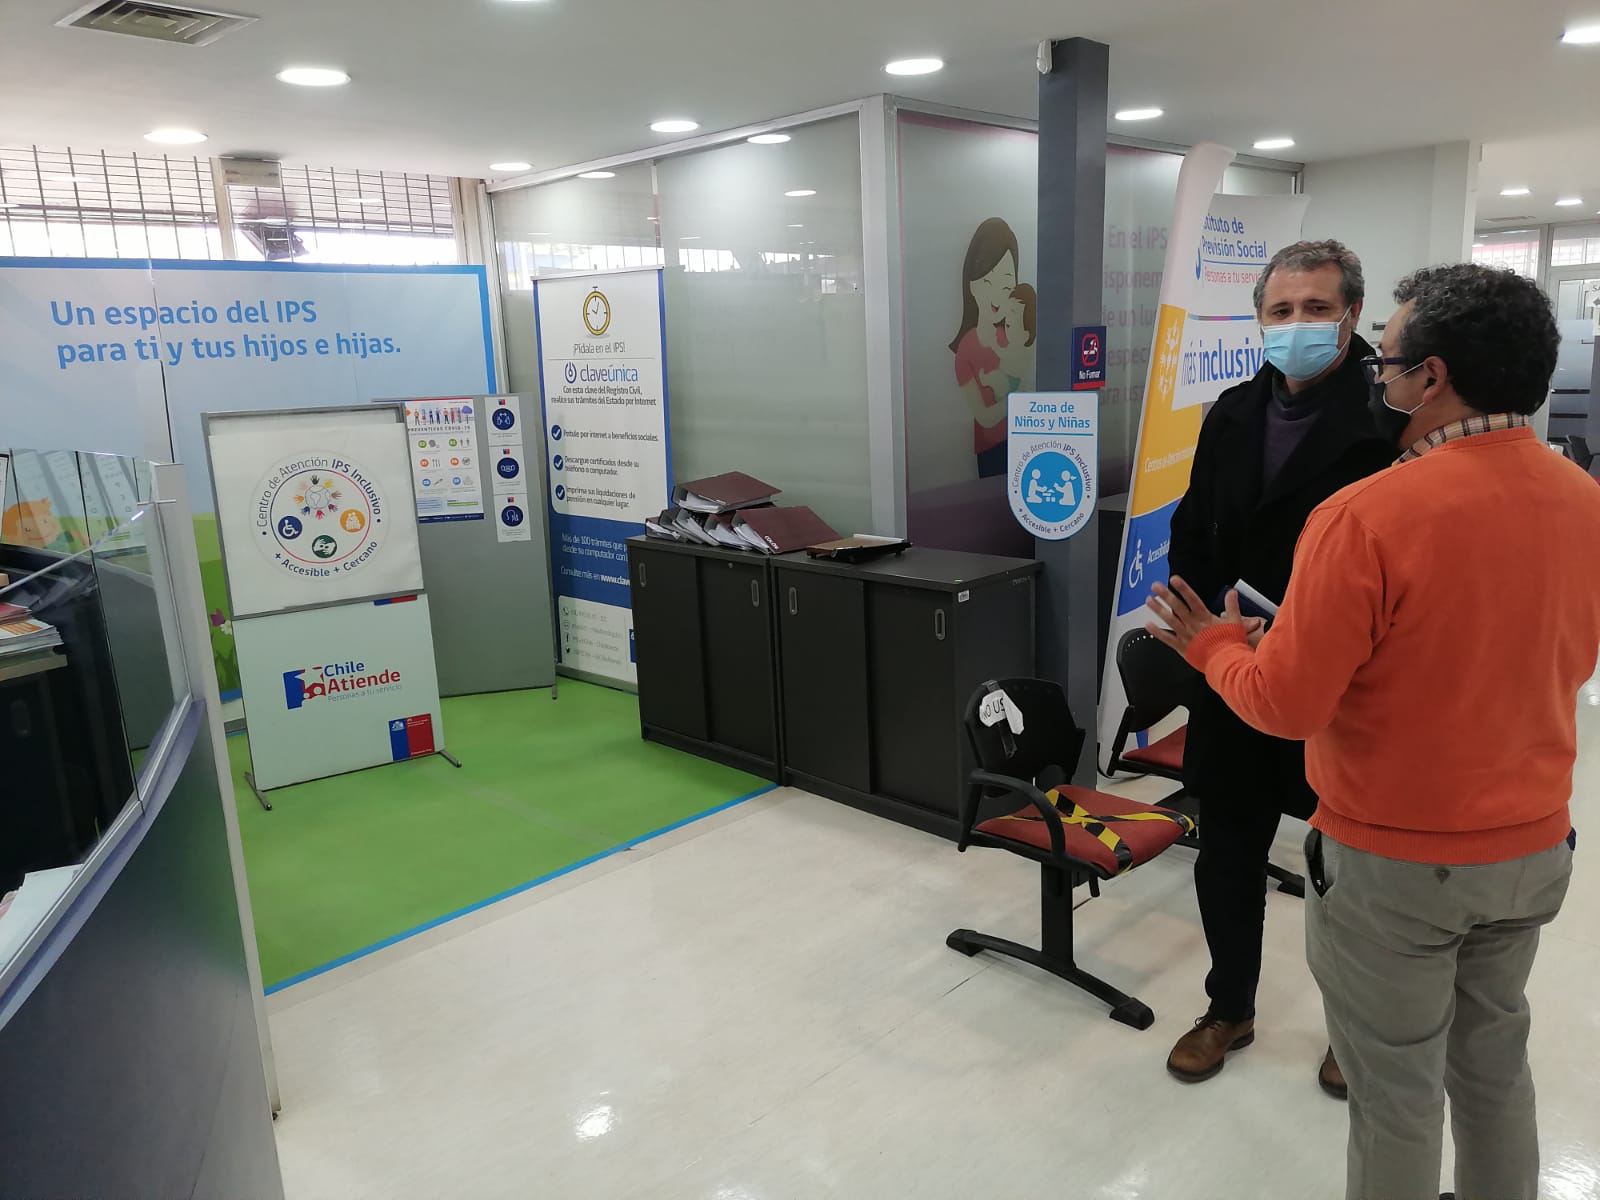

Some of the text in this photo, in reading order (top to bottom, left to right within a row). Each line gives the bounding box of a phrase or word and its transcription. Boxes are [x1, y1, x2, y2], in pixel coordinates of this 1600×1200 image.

[1232, 216, 1245, 234] de
[1108, 224, 1168, 250] En el IPS
[1202, 235, 1267, 258] Previsión Social
[51, 300, 317, 330] Un espacio del IPS
[58, 333, 401, 369] para ti y tus hijos e hijas.
[595, 345, 603, 354] en
[1199, 337, 1265, 382] inclusiv
[580, 363, 638, 382] claveúnica
[1079, 369, 1101, 380] No Fumar
[563, 386, 572, 394] Con
[1029, 401, 1075, 413] Zona de
[1014, 415, 1090, 430] Niños y Niñas
[1011, 440, 1092, 492] Centro de Atención IPS Inclusivo
[256, 457, 381, 527] Centro de Atención IPS Inclusivo
[1021, 513, 1052, 534] Accesible
[1059, 512, 1085, 532] Cercano
[281, 559, 330, 577] Accesible
[343, 541, 378, 571] Cercano
[323, 661, 365, 677] Chile
[328, 669, 401, 694] Atiende
